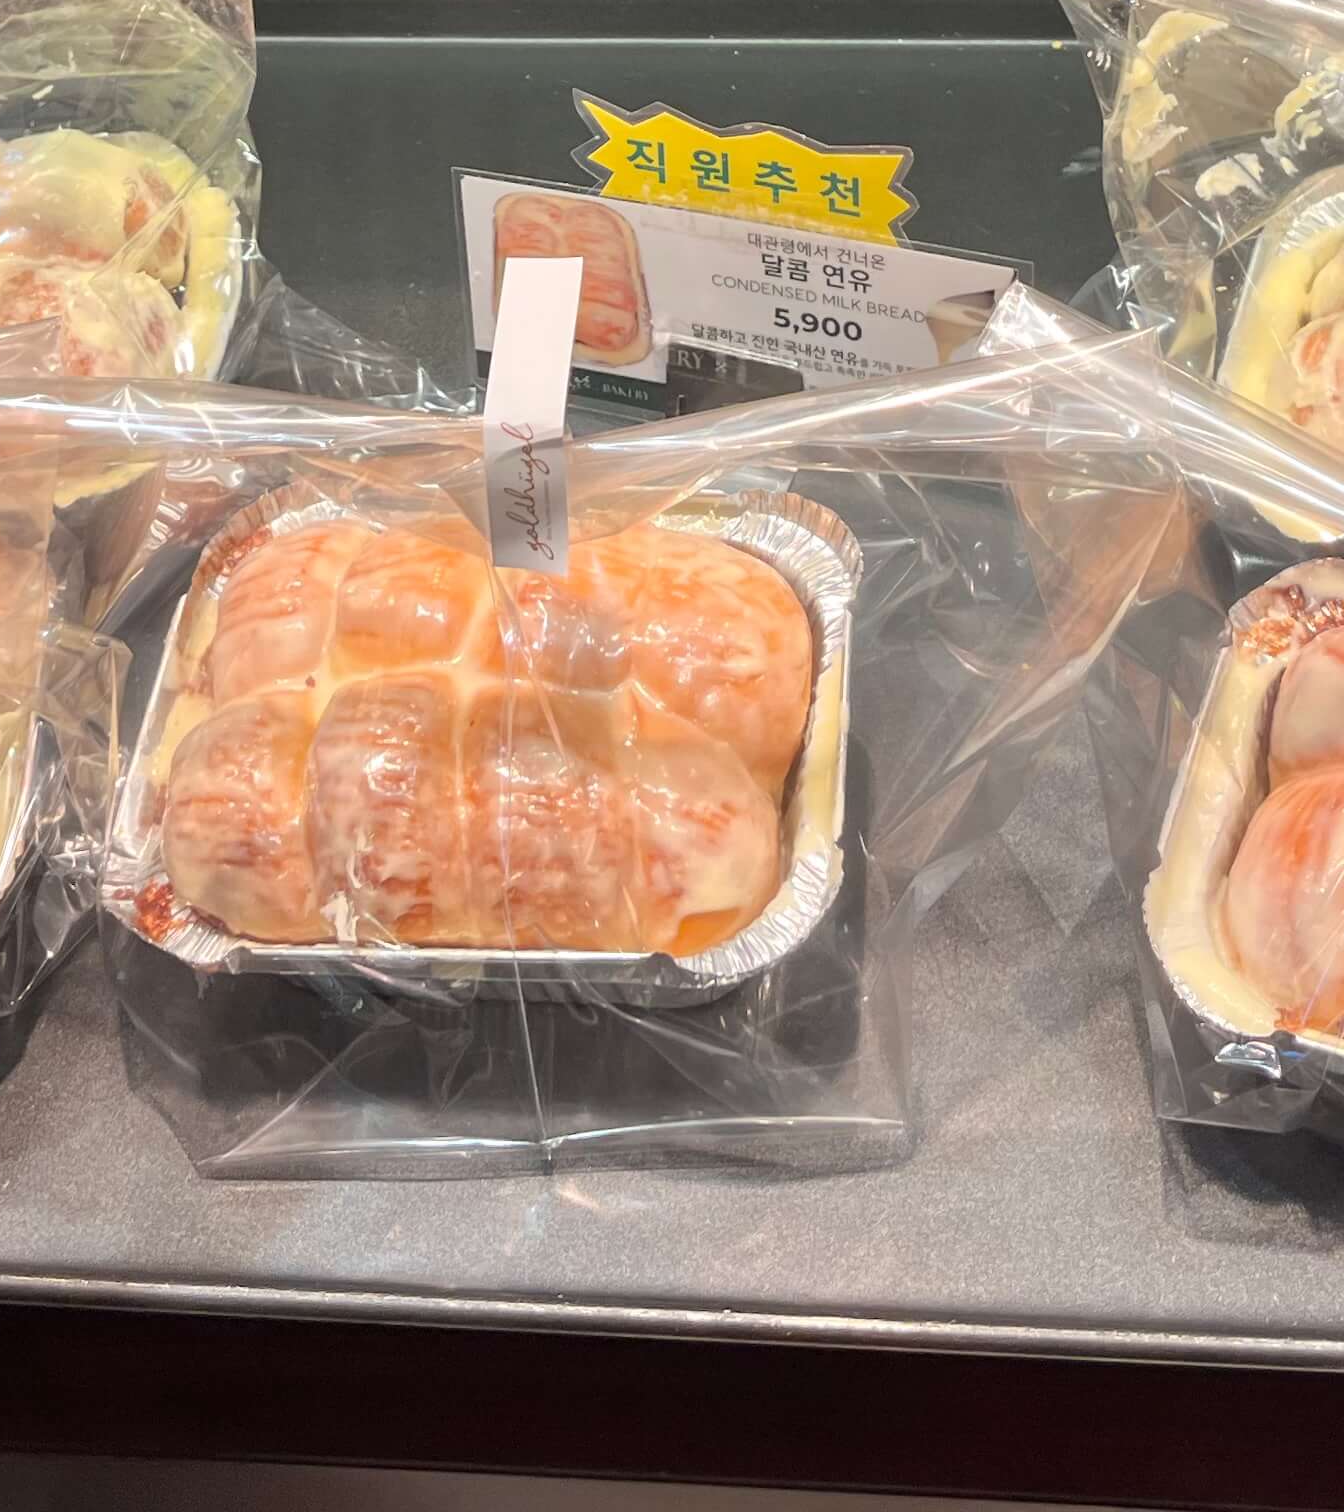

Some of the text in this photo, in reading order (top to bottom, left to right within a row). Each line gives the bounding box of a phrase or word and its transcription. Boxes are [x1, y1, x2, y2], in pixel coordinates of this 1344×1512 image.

[747, 232, 887, 271] 대관령에서 건너온
[761, 253, 873, 294] 달콤 연유
[711, 274, 927, 324] CONDENSED MILK BREAD
[690, 323, 748, 345] 달콤하고
[783, 339, 827, 362] 국내산
[773, 307, 863, 342] 5,900
